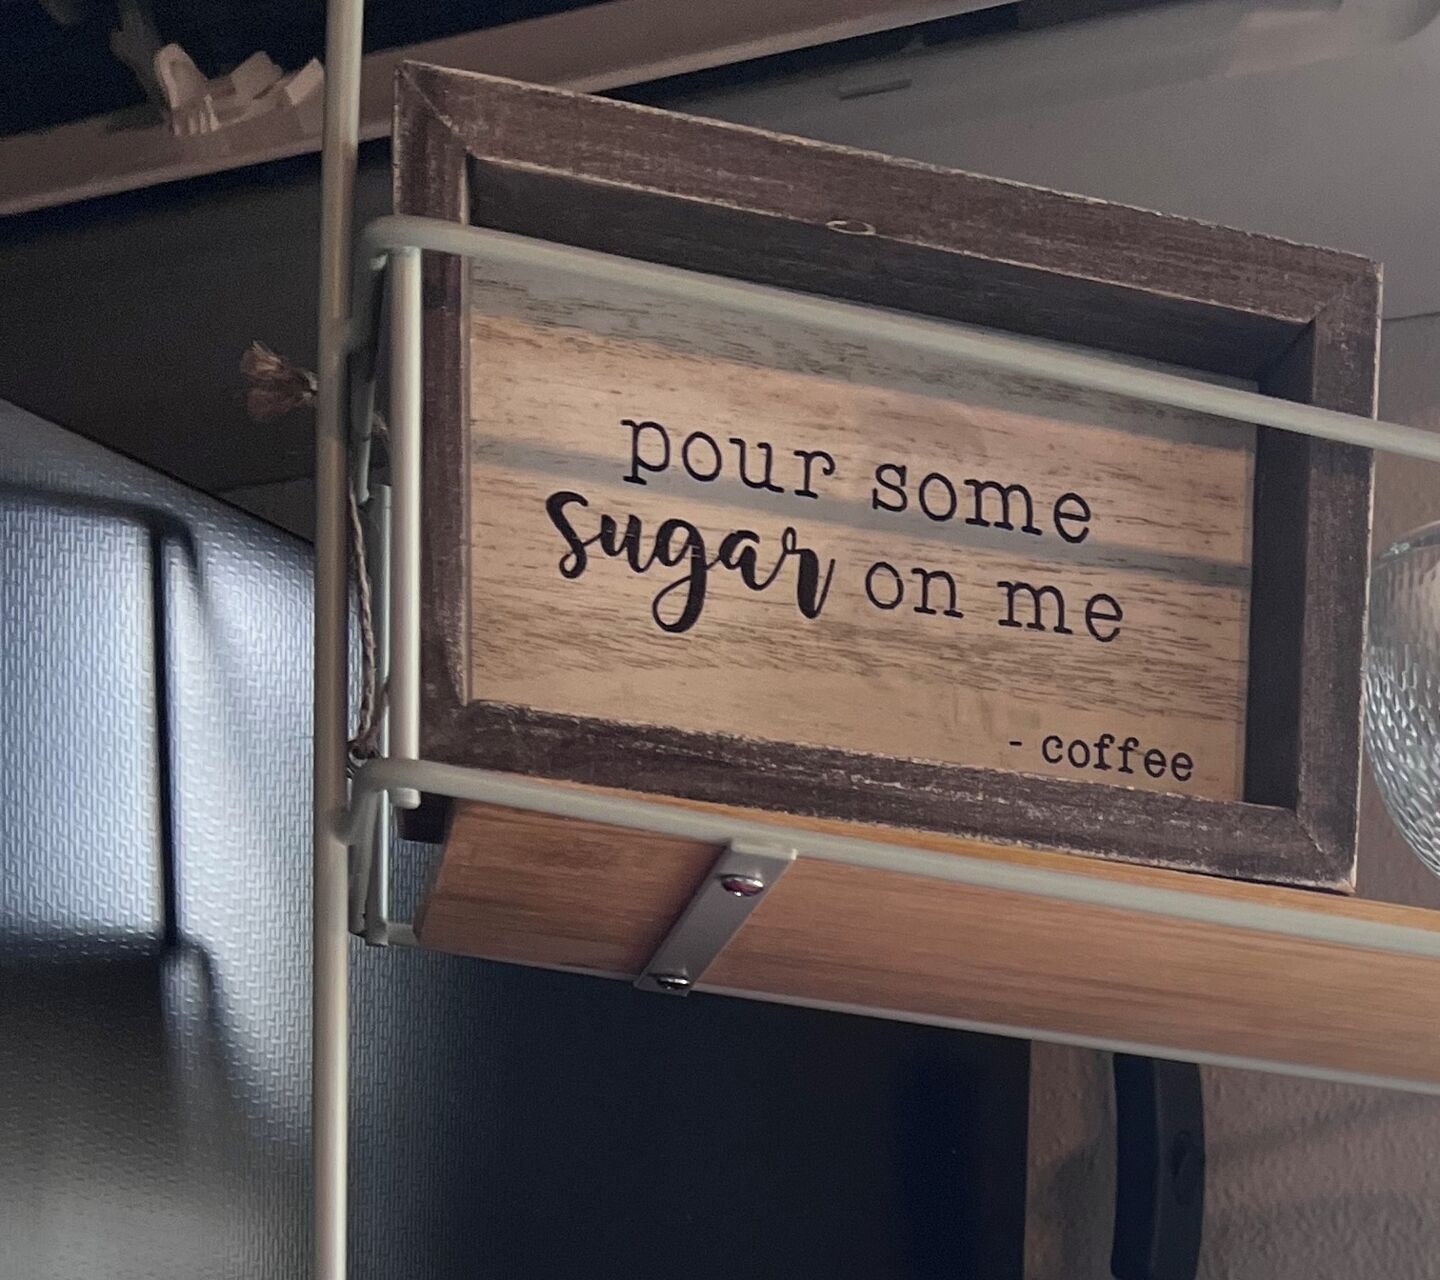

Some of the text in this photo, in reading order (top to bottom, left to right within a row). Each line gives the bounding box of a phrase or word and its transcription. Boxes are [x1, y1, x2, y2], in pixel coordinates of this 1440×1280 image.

[621, 416, 1093, 545] pour some
[545, 490, 1125, 643] sugar on me
[1041, 732, 1195, 782] coffee
